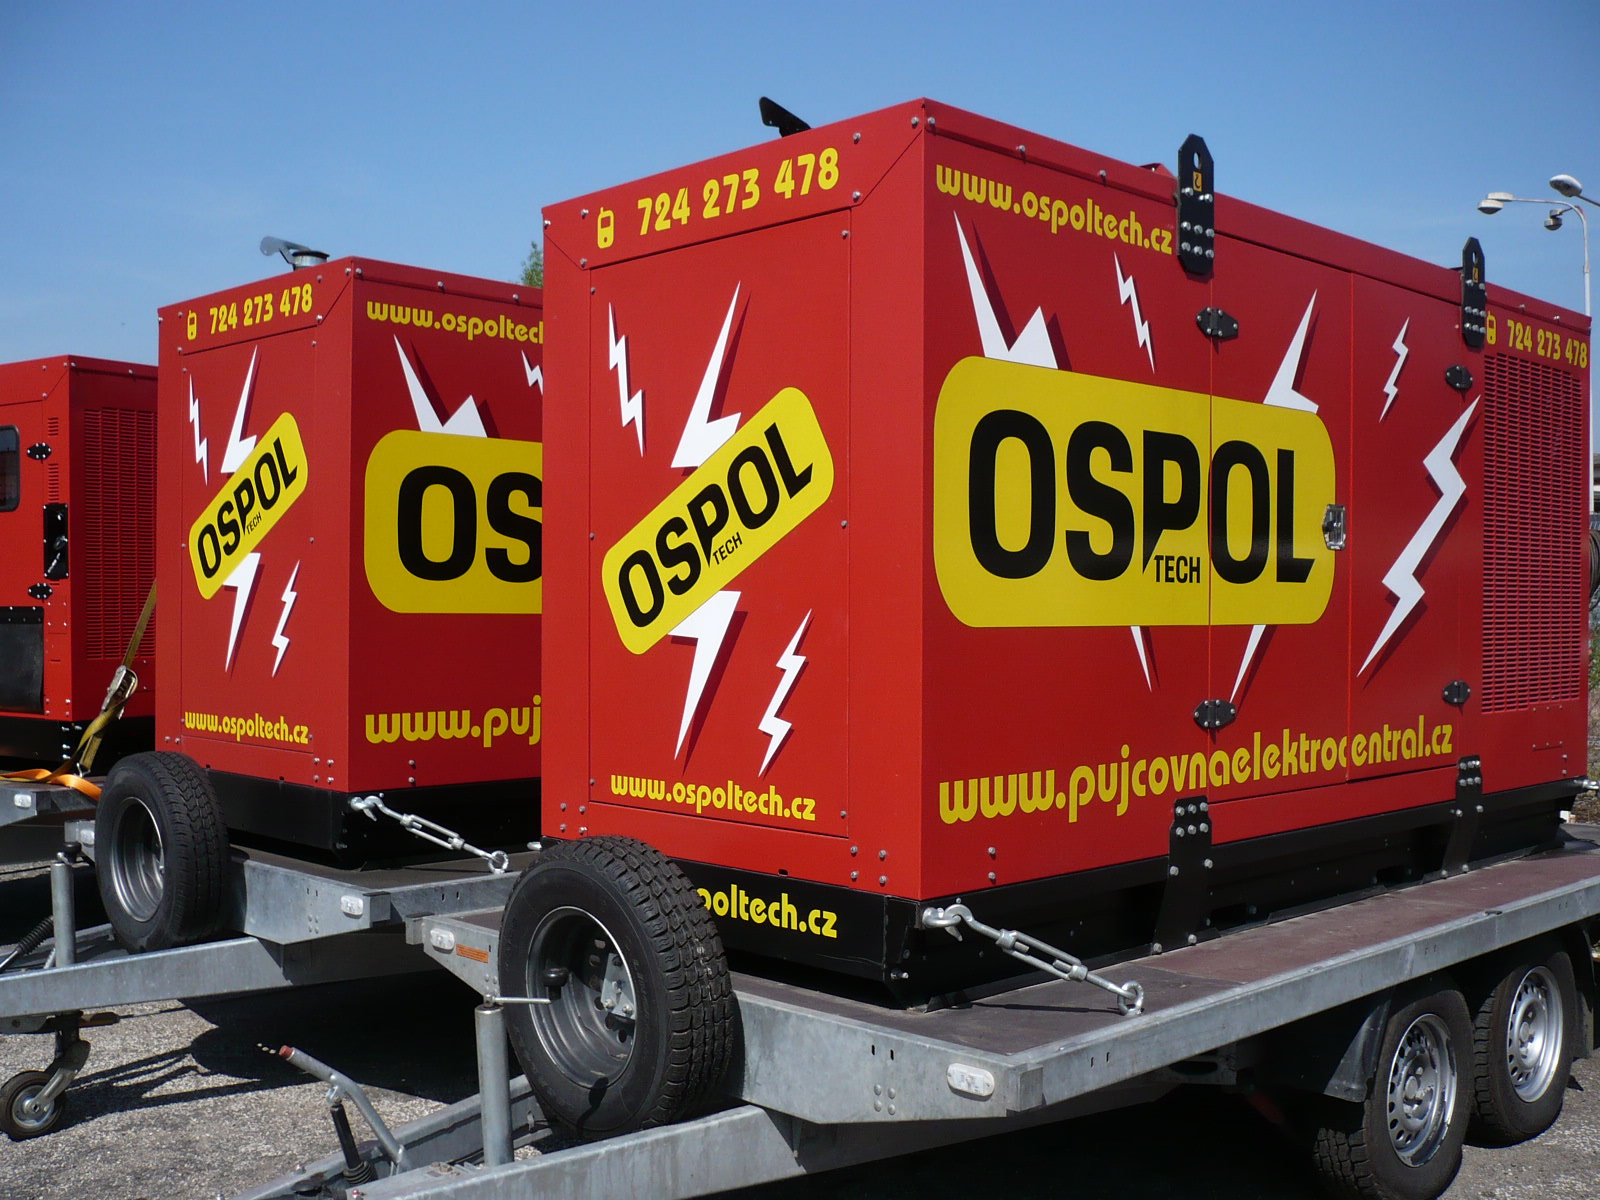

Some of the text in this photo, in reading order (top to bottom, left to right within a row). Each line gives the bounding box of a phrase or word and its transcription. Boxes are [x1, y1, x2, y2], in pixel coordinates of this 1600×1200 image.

[638, 146, 840, 236] 724 273 478
[936, 163, 1173, 256] www.ospoltech.cz
[209, 283, 314, 335] 724 273 478
[1507, 319, 1588, 369] 724 273 478
[197, 437, 298, 579] OSPOL
[246, 511, 262, 535] TECH
[968, 409, 1315, 585] OSPOL
[397, 465, 543, 584] OS
[619, 422, 814, 628] OSPOL
[712, 531, 743, 565] TECH
[1154, 554, 1201, 584] TECH
[184, 711, 309, 745] www.ospoltech.cz
[365, 694, 543, 748] www.puj
[939, 714, 1453, 825] www.pujcovnaelektrocentral.cz
[610, 774, 817, 822] www.ospoltech.cz
